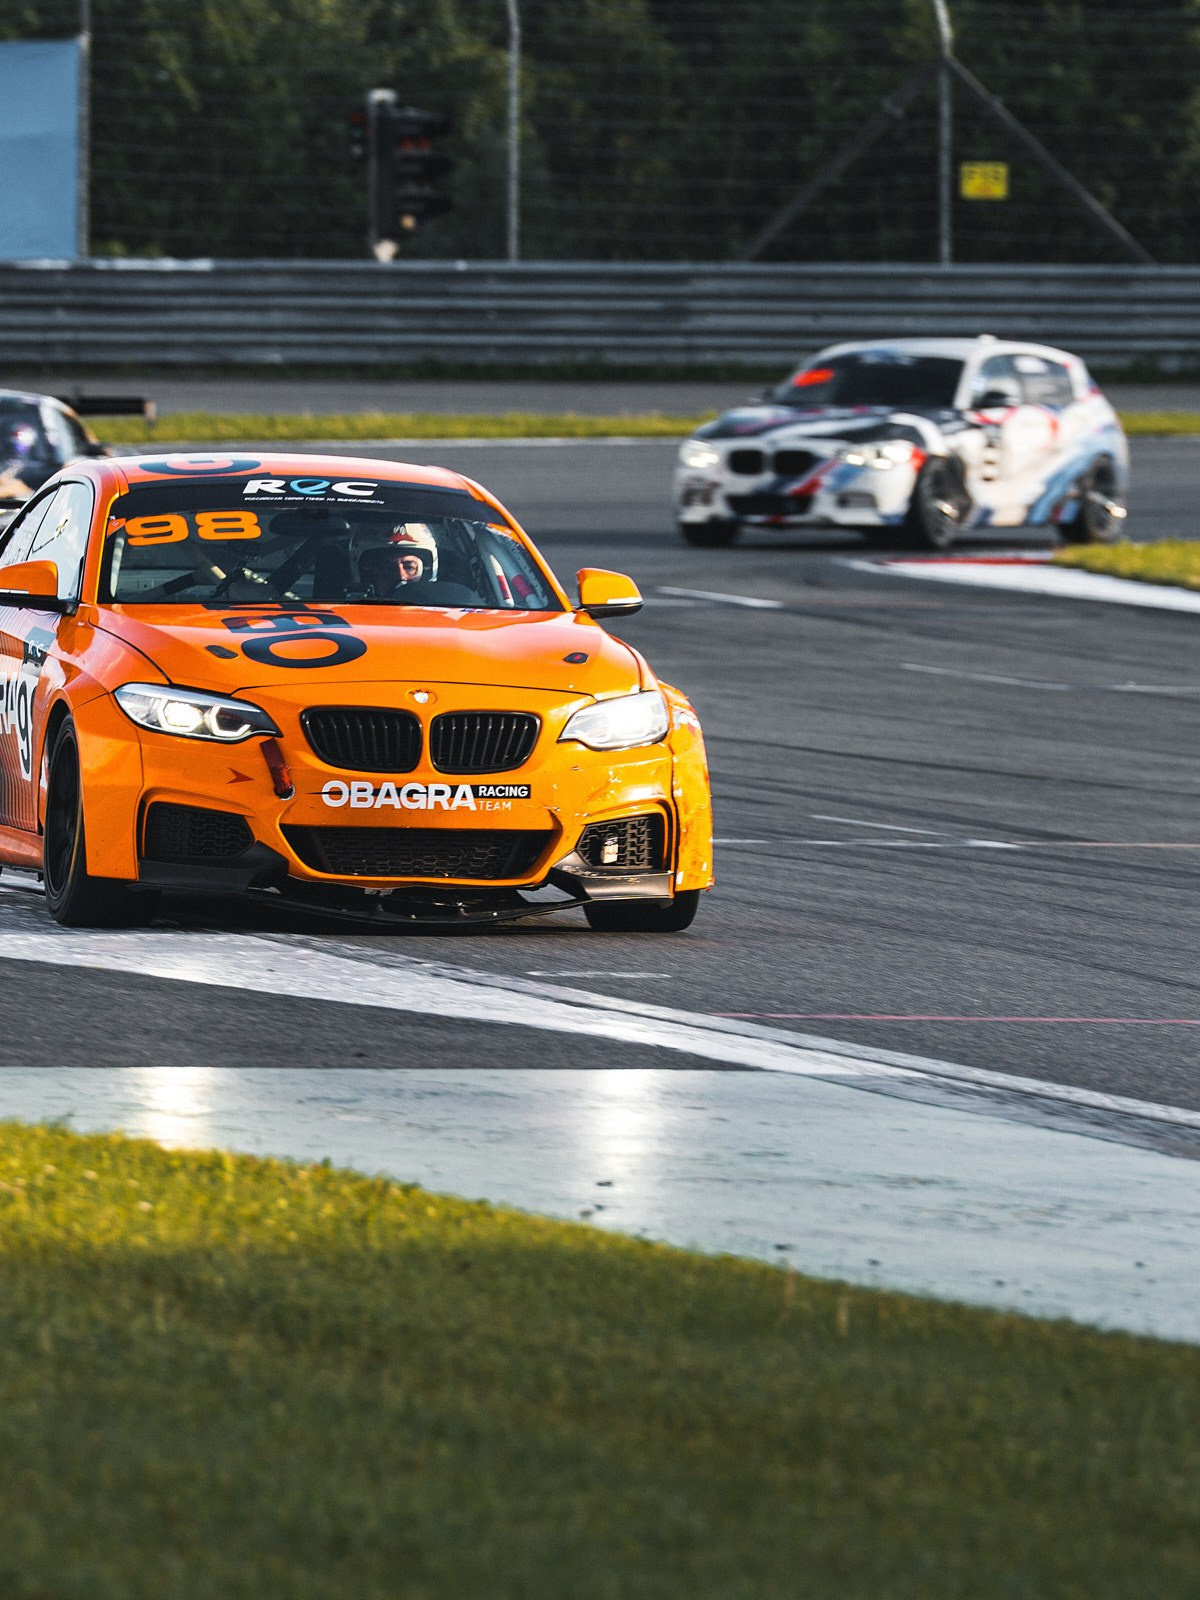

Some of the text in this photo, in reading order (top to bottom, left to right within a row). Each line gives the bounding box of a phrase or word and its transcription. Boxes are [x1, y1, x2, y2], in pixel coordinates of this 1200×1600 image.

[125, 511, 262, 546] 98
[321, 780, 529, 811] OBAGRA RACING
[479, 800, 512, 811] TEAM
